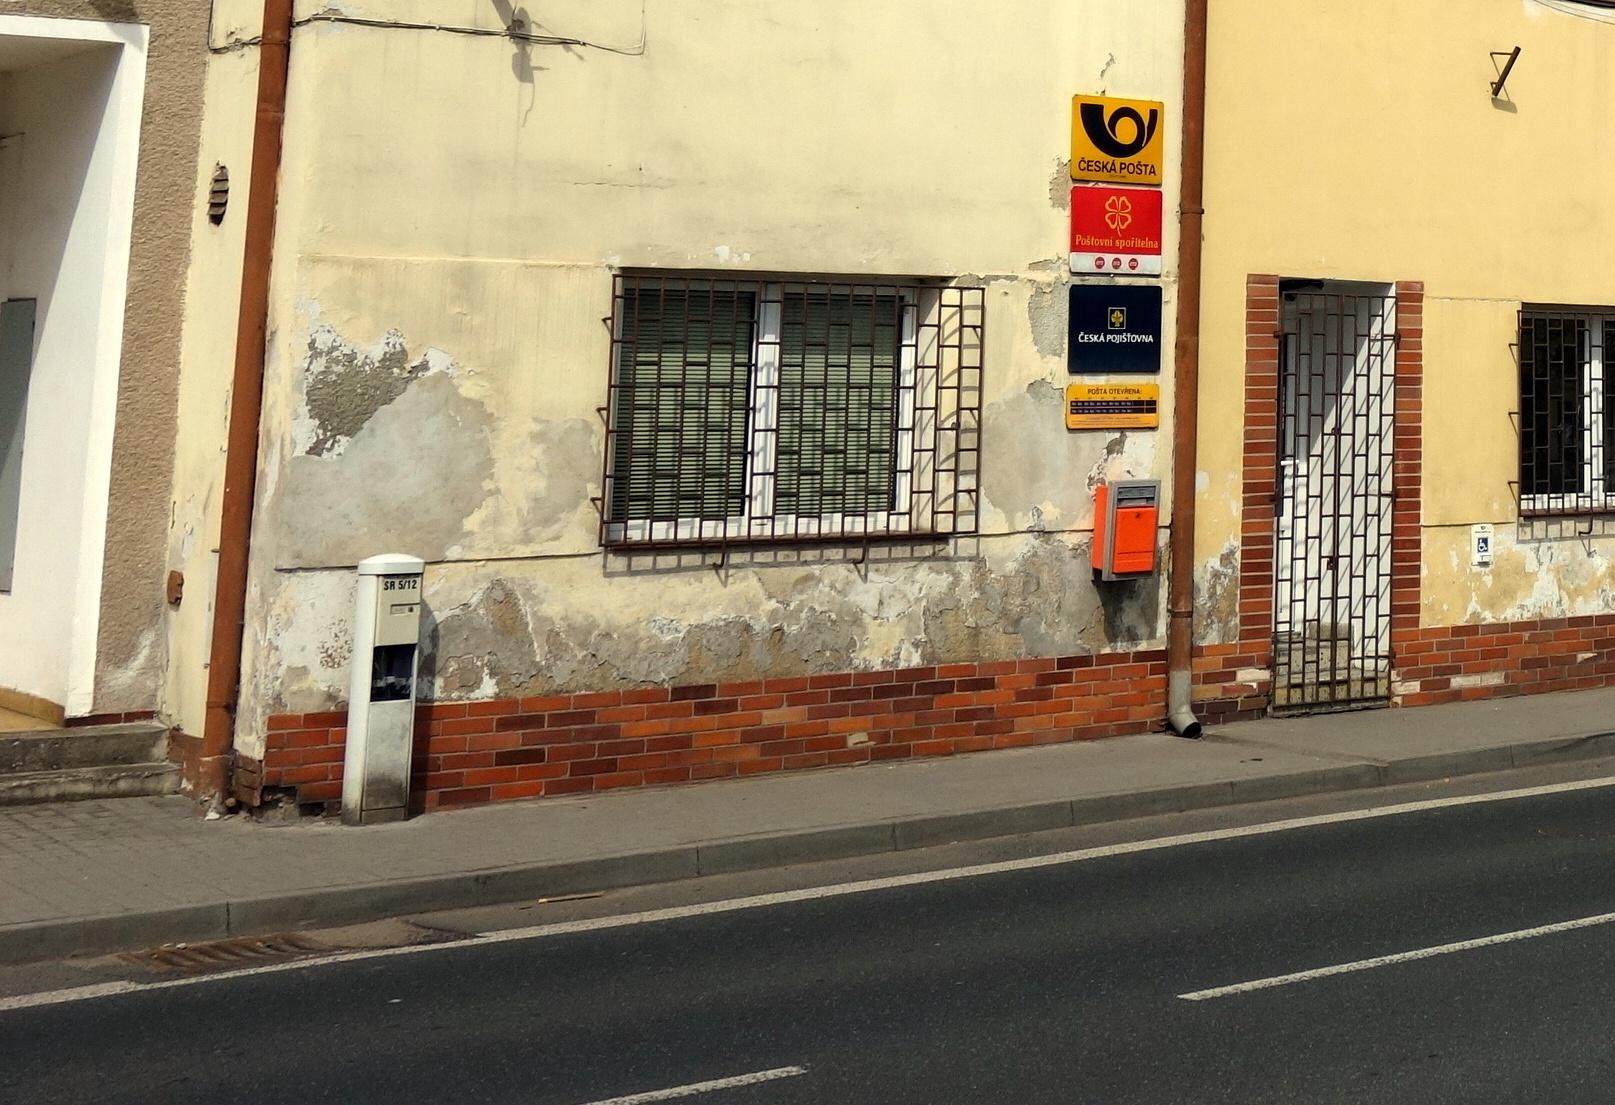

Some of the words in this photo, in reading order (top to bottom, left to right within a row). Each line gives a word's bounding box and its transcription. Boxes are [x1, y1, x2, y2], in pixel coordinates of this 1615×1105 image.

[1078, 157, 1118, 174] ČESKÁ
[1119, 160, 1157, 177] POŠTA
[1075, 234, 1113, 247] Poštovní
[1115, 236, 1159, 250] spořitelna
[1078, 331, 1105, 343] ČESKÁ
[1106, 332, 1154, 344] POJIŠŤOVNA
[1087, 386, 1107, 395] POŠTA
[398, 579, 417, 590] 5/12
